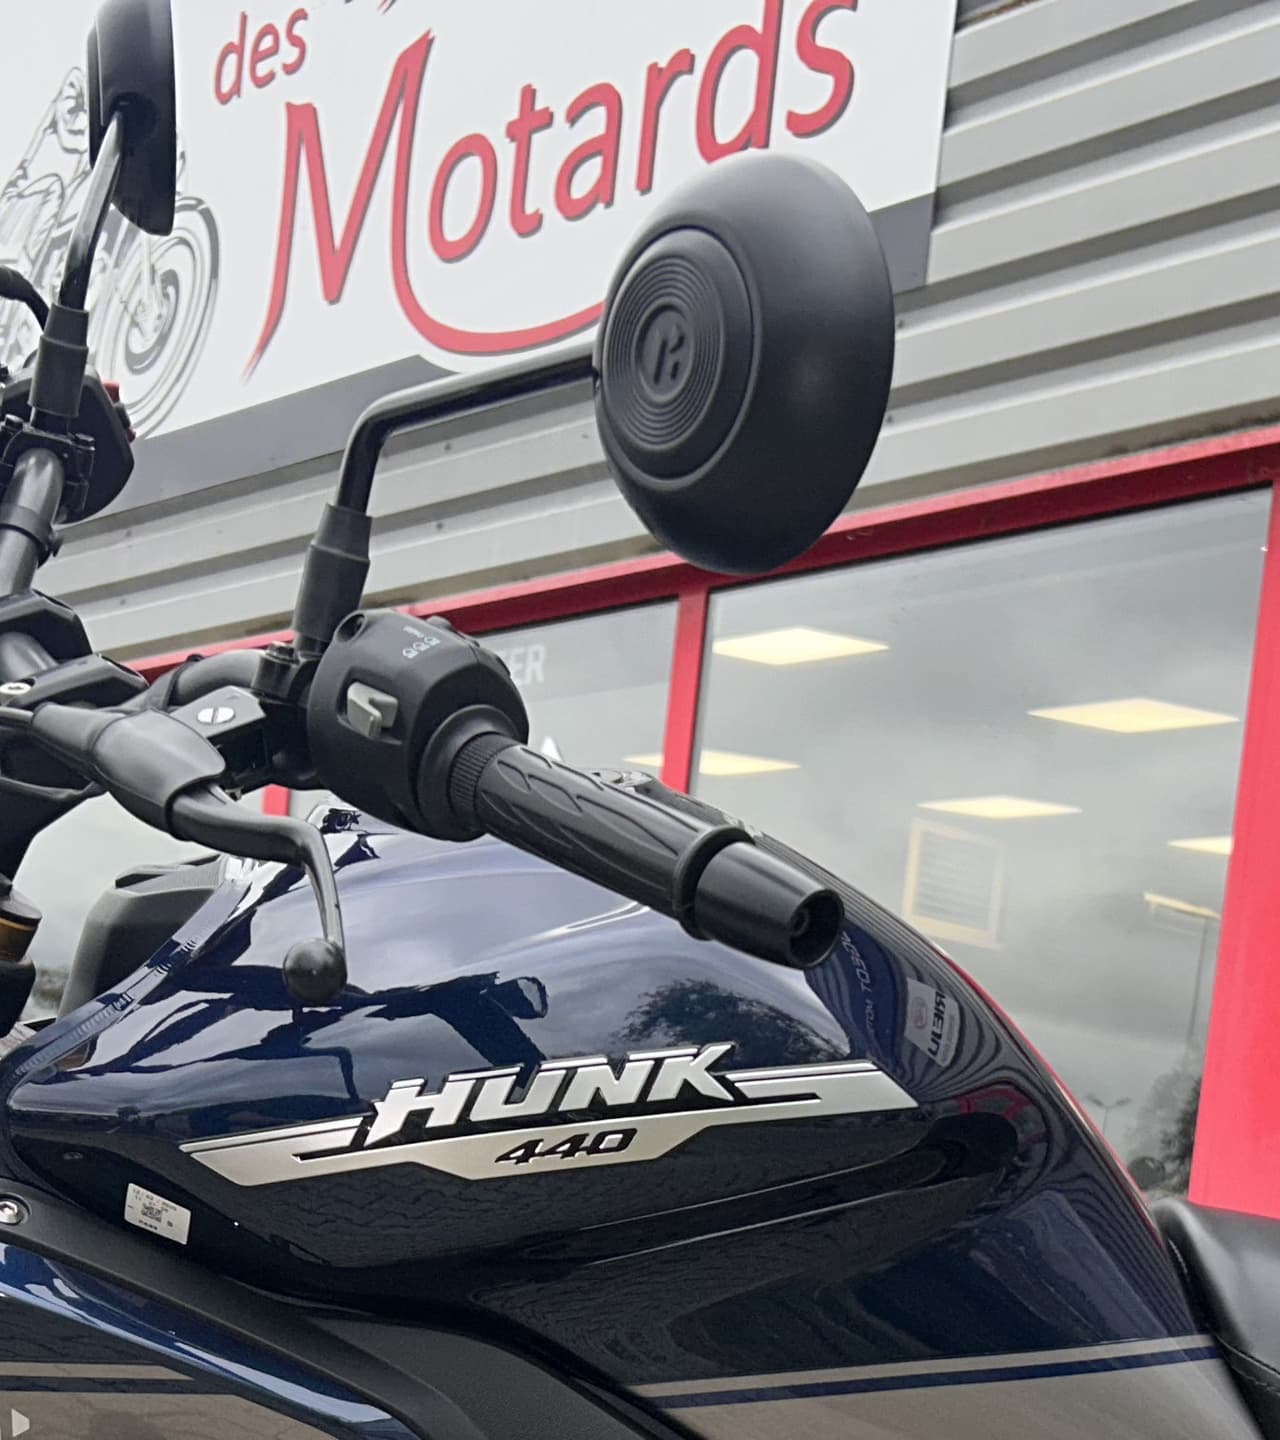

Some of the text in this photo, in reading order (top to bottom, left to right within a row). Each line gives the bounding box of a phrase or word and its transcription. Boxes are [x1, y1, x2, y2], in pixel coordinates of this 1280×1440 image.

[214, 8, 308, 106] des
[243, 0, 858, 380] Motards
[363, 1041, 736, 1148] HUNK
[495, 1127, 638, 1165] 440
